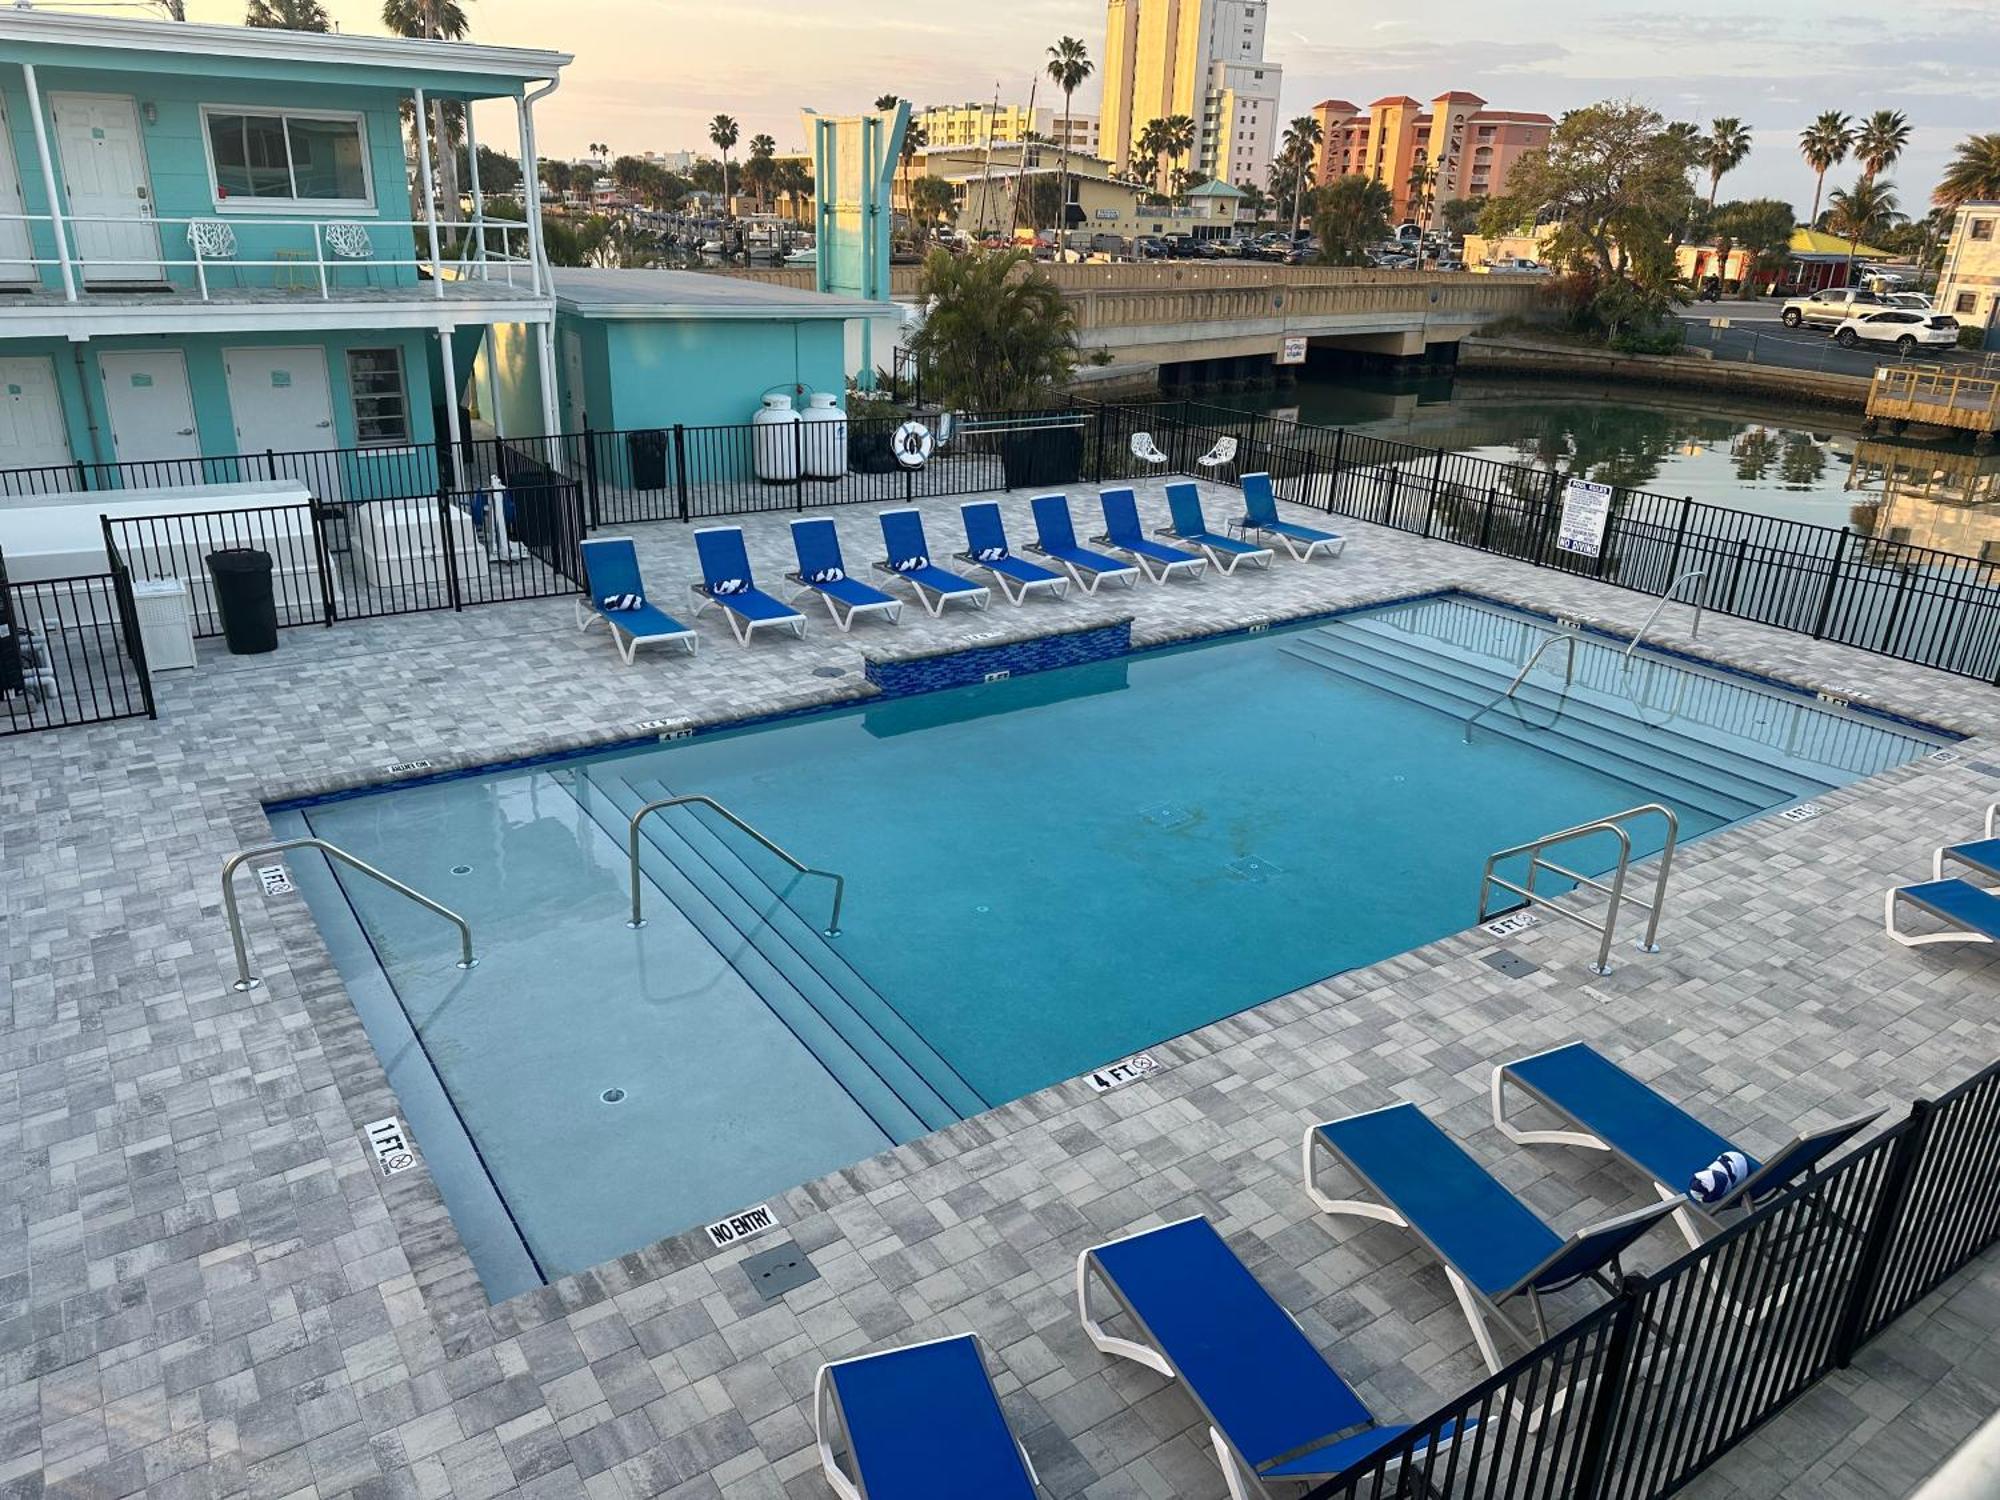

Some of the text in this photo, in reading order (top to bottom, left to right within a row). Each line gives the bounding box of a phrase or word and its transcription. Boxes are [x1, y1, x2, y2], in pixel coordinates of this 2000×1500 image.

[1488, 924, 1506, 934] 5
[1093, 1074, 1111, 1088] 4
[371, 1123, 395, 1135] 1
[710, 1207, 772, 1244] NO ENTRY
